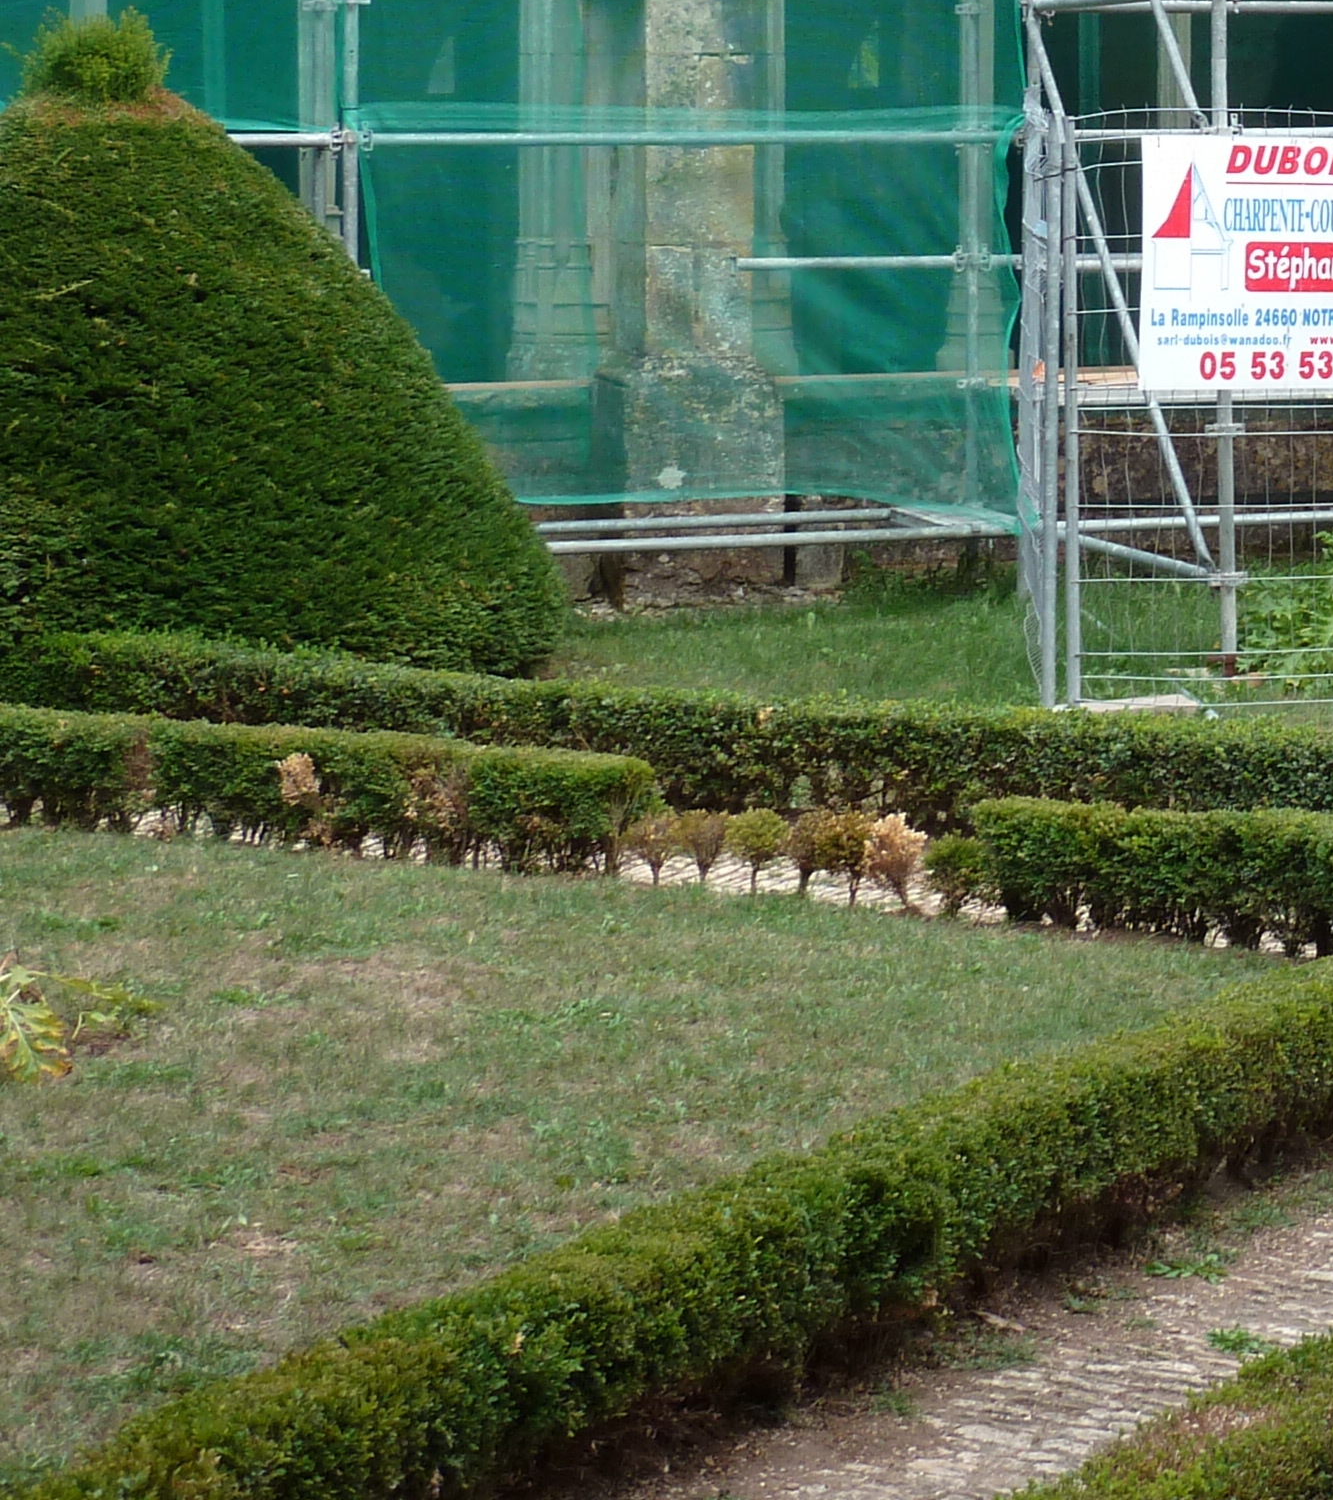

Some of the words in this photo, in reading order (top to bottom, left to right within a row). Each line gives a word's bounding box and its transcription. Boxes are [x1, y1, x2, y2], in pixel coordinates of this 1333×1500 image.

[1151, 308, 1165, 326] La
[1171, 308, 1249, 330] Rampinsolle
[1255, 308, 1297, 327] 24660
[1157, 334, 1292, 346] sarl-dubois@wanadoo.fr
[1200, 351, 1236, 380] 05
[1251, 351, 1285, 380] 53
[1299, 351, 1333, 380] 53
